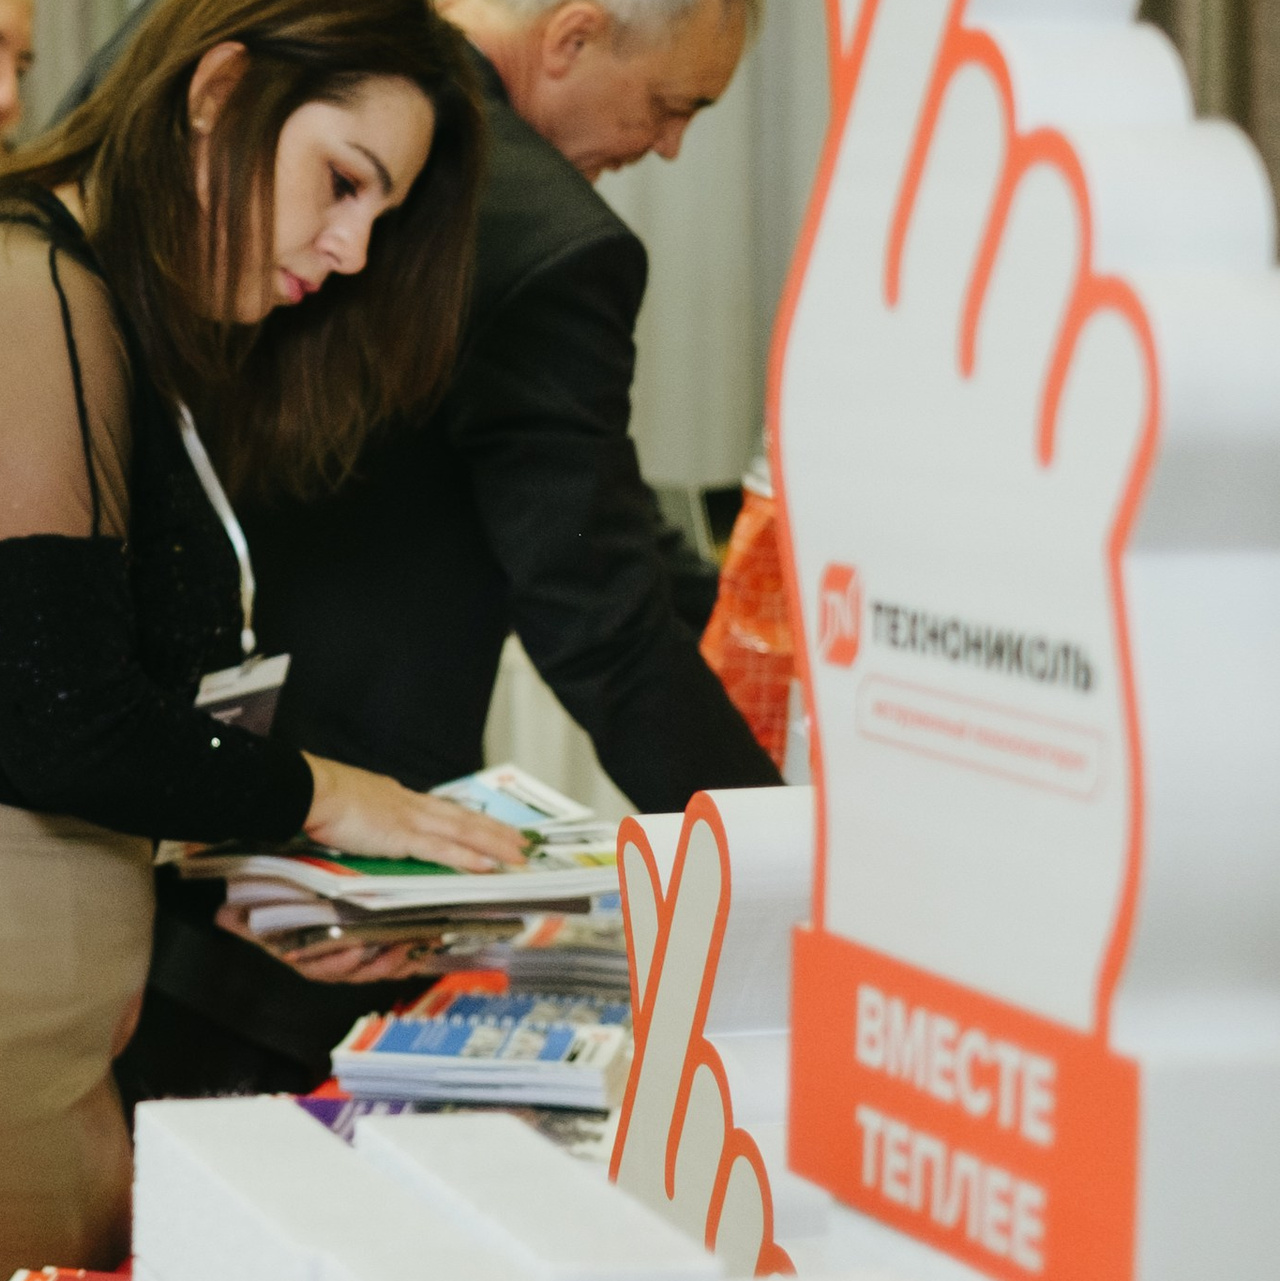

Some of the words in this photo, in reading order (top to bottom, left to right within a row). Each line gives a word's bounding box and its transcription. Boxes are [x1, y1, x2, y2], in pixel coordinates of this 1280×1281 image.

[871, 600, 1094, 695] ТЕХНОНИКОЛЬ
[855, 982, 1057, 1148] ВМЕСТЕ
[855, 1102, 1047, 1276] ТЕПЛЕЕ
